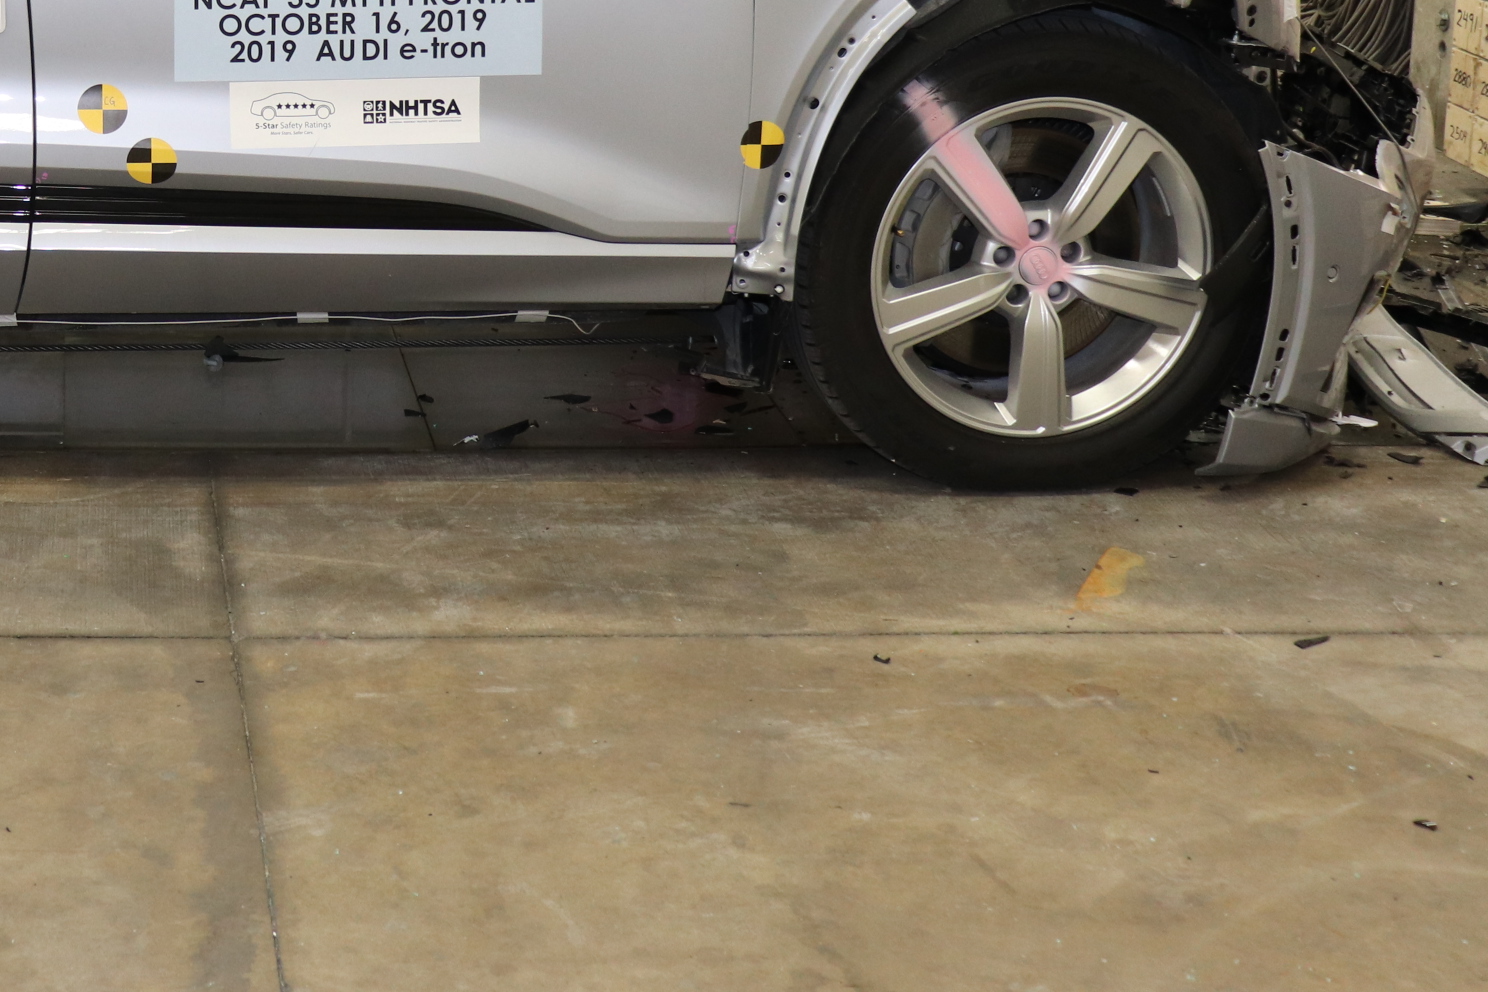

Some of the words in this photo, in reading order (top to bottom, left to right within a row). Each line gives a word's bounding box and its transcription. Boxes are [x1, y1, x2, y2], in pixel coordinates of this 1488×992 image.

[218, 12, 357, 37] OCTOBER
[371, 11, 410, 37] 16,
[420, 8, 488, 33] 2019
[1456, 9, 1478, 33] 2491
[229, 40, 297, 63] 2019
[315, 39, 389, 62] AUDI
[398, 36, 487, 60] e-tron
[389, 98, 462, 117] NHTSA
[255, 122, 279, 130] 5-Star
[280, 121, 303, 131] Safety
[304, 121, 332, 130] Ratings
